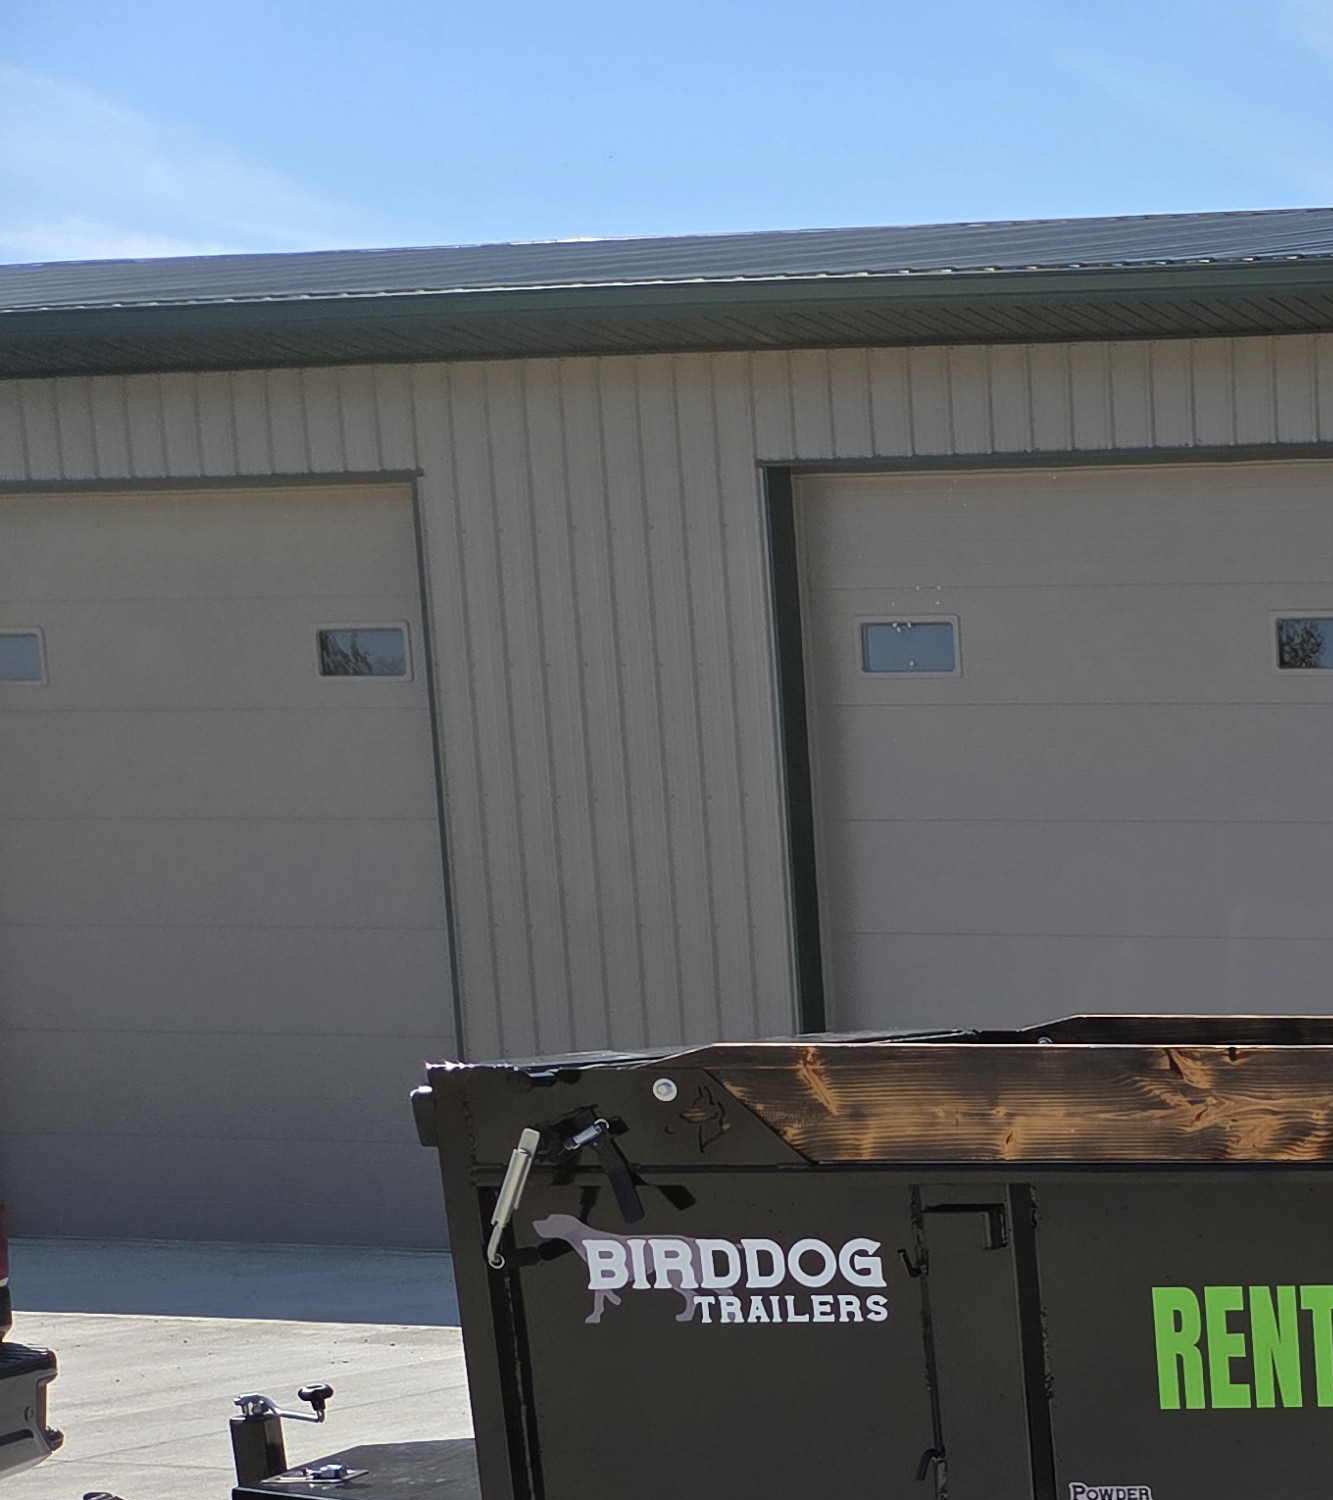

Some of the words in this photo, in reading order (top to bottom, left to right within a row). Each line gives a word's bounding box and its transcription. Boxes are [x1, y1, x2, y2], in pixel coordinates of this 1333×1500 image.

[583, 1238, 887, 1290] BIRDDOG
[692, 1295, 888, 1323] TRAILERS
[1072, 1484, 1150, 1500] POWDER
